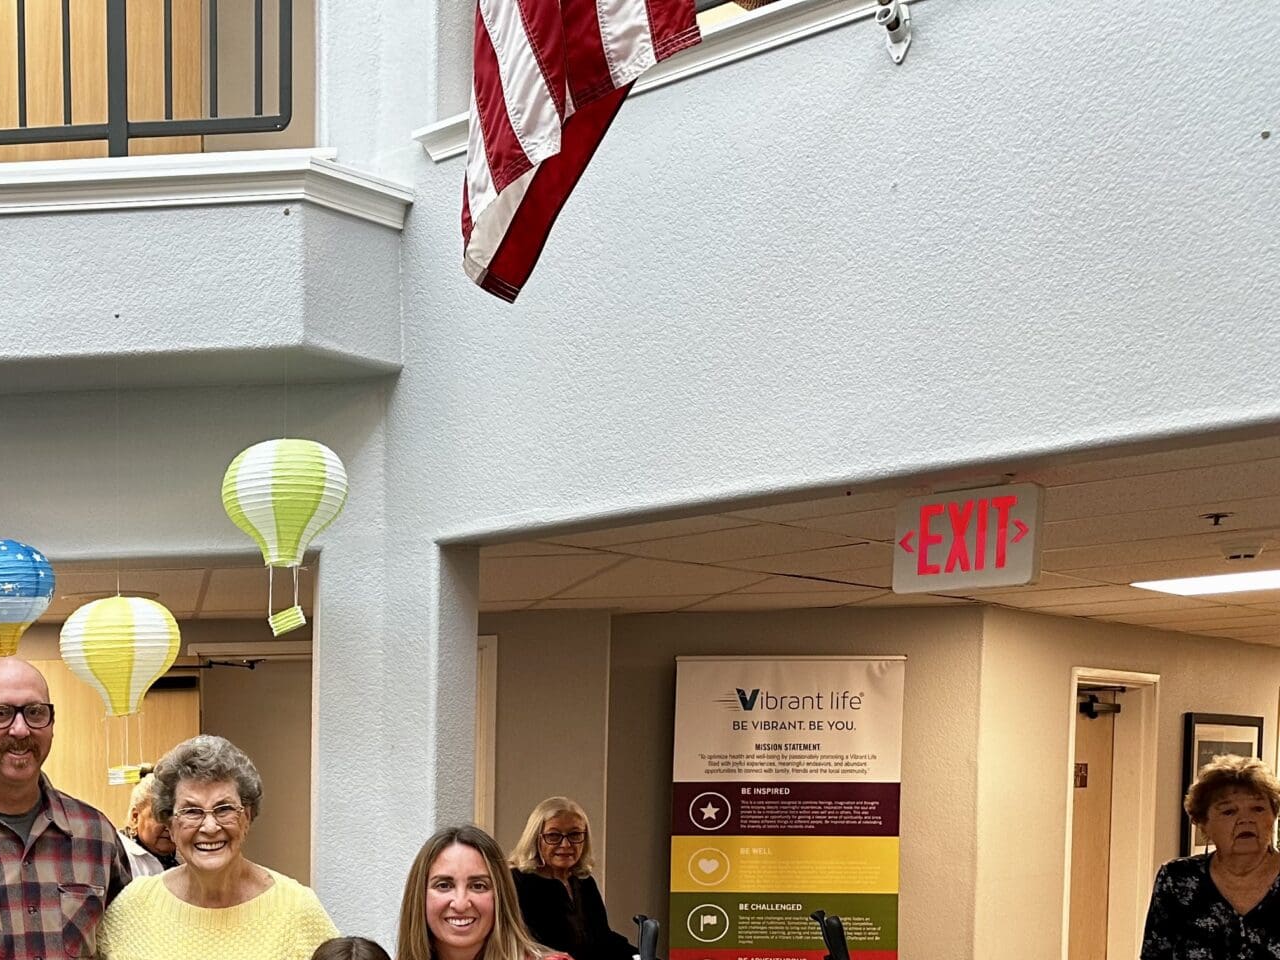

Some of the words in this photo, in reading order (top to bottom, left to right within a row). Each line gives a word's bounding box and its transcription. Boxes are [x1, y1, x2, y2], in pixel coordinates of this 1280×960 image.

[918, 495, 1017, 576] EXIT
[735, 688, 824, 711] Vibrant
[830, 690, 862, 710] life
[732, 720, 748, 731] BE
[752, 720, 806, 731] VIBRANT.
[809, 720, 824, 731] BE
[827, 720, 857, 731] YOU.
[755, 743, 783, 751] MISSION
[784, 743, 820, 751] STATEMENT
[741, 787, 752, 795] BE
[753, 787, 790, 795] INSPIRED
[740, 847, 750, 855] BE
[752, 847, 771, 855] WELL
[739, 903, 749, 911] BE
[750, 903, 803, 911] CHALLENGED
